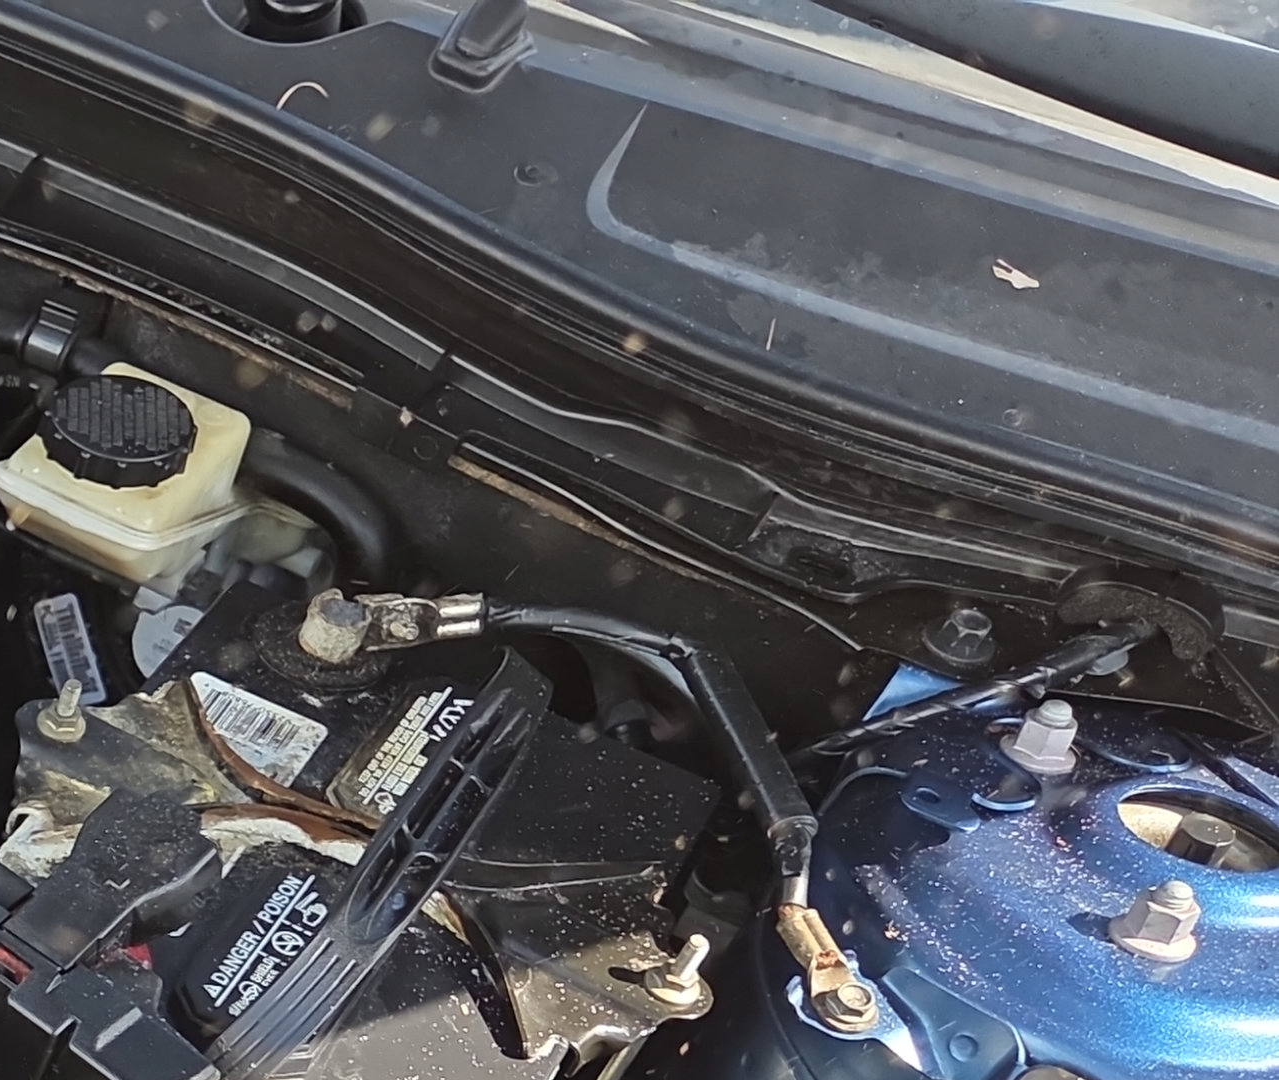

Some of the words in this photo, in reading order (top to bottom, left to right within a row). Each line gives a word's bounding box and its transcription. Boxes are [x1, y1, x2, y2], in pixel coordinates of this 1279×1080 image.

[210, 930, 262, 986] DANGER
[257, 873, 304, 924] POISON
[250, 955, 275, 983] SHIELD
